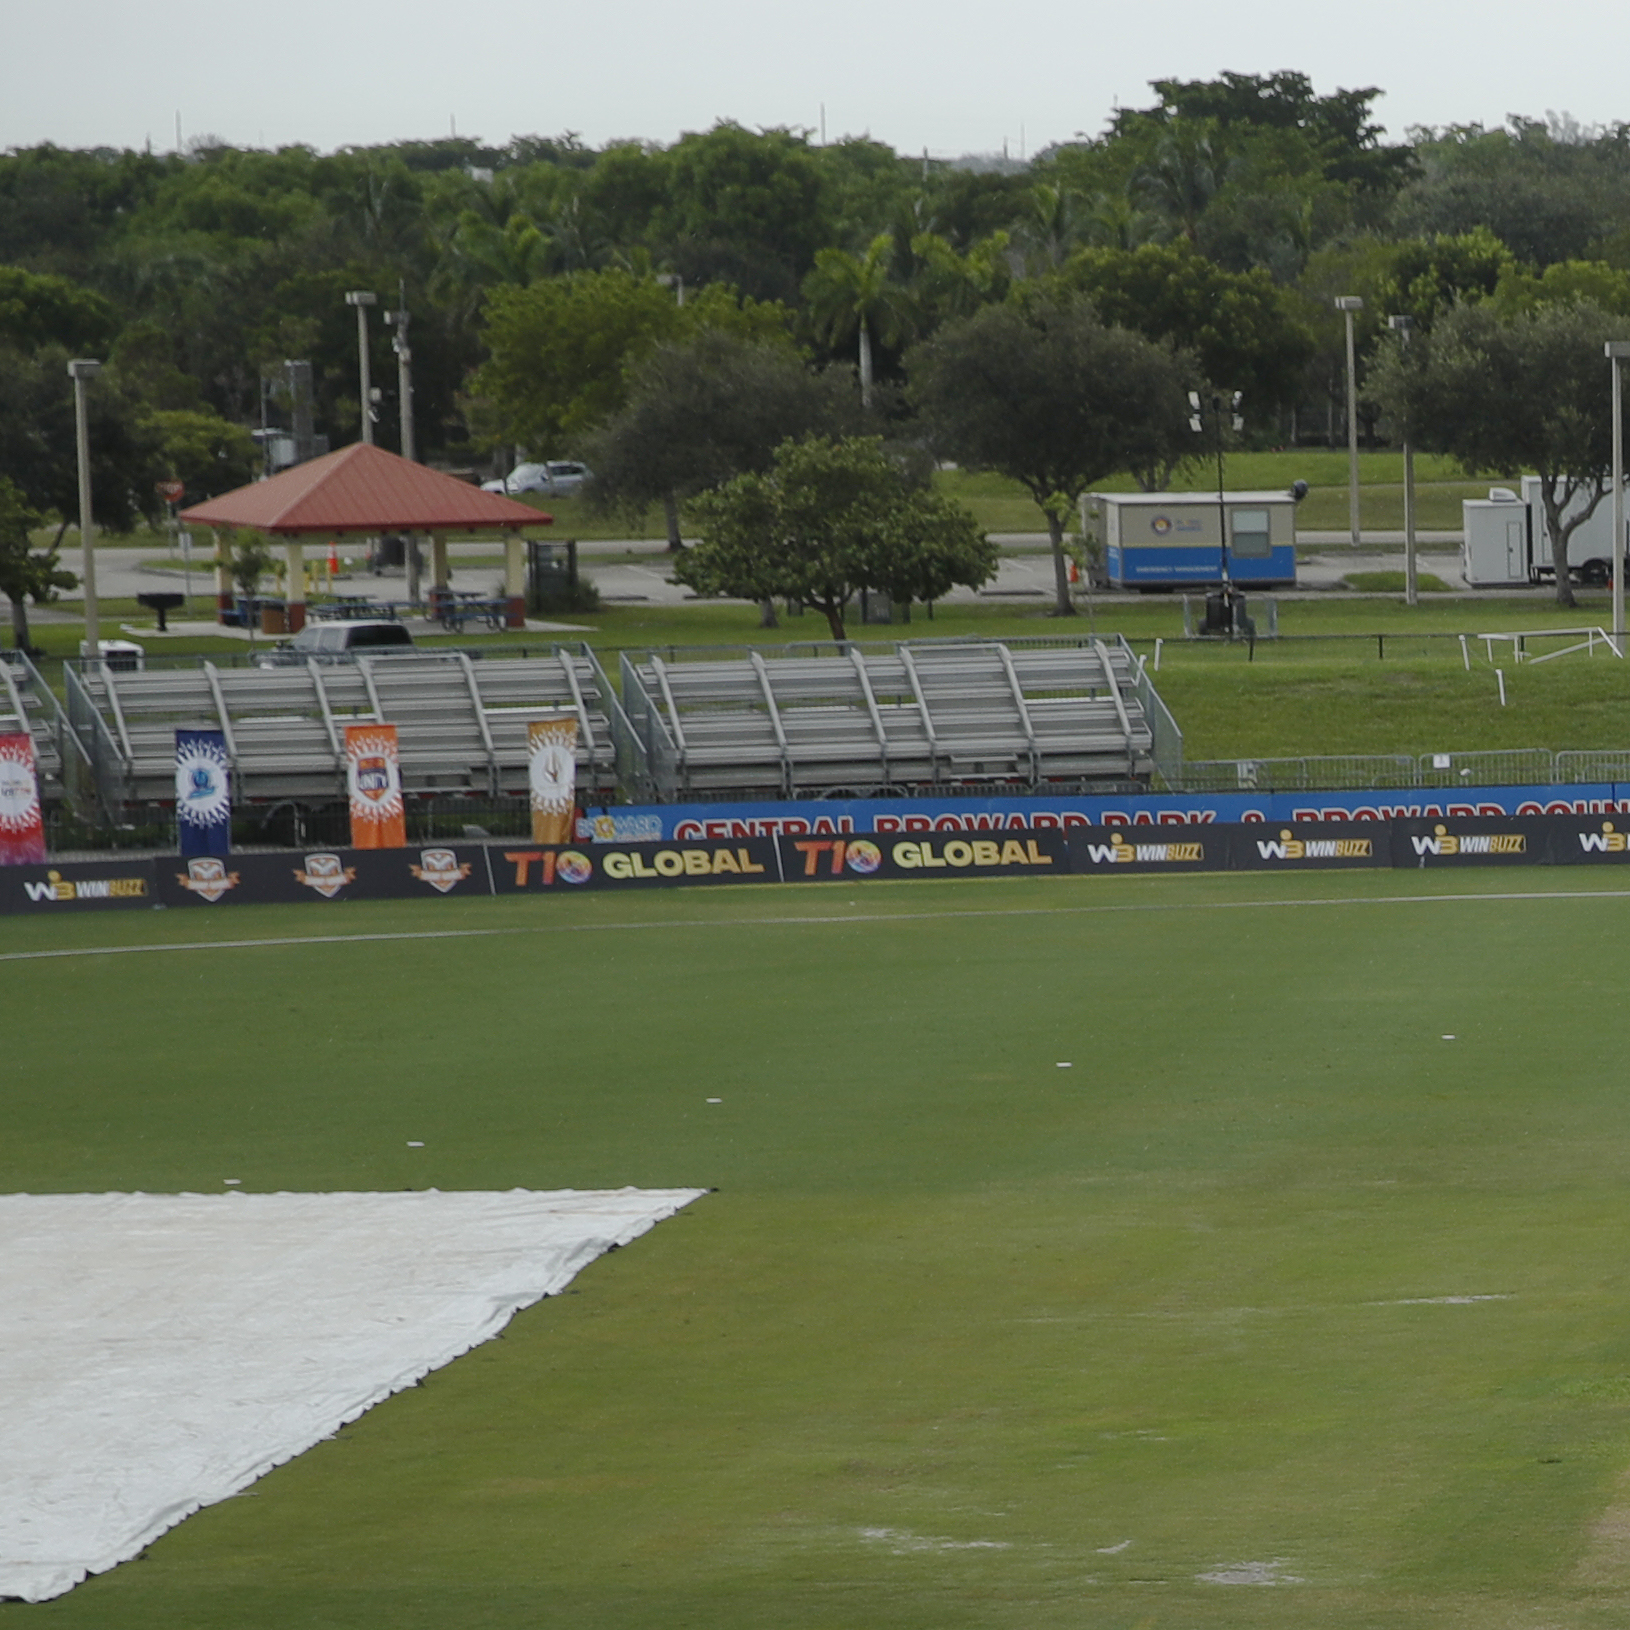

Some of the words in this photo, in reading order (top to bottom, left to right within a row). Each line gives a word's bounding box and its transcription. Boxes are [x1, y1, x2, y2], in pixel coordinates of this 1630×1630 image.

[1136, 844, 1201, 861] WINBUZZ
[1305, 840, 1370, 857] WINBUZZ
[1460, 835, 1524, 853] WINBUZZ
[892, 840, 1053, 868] GLOBAL
[602, 849, 765, 879] GLOBAL
